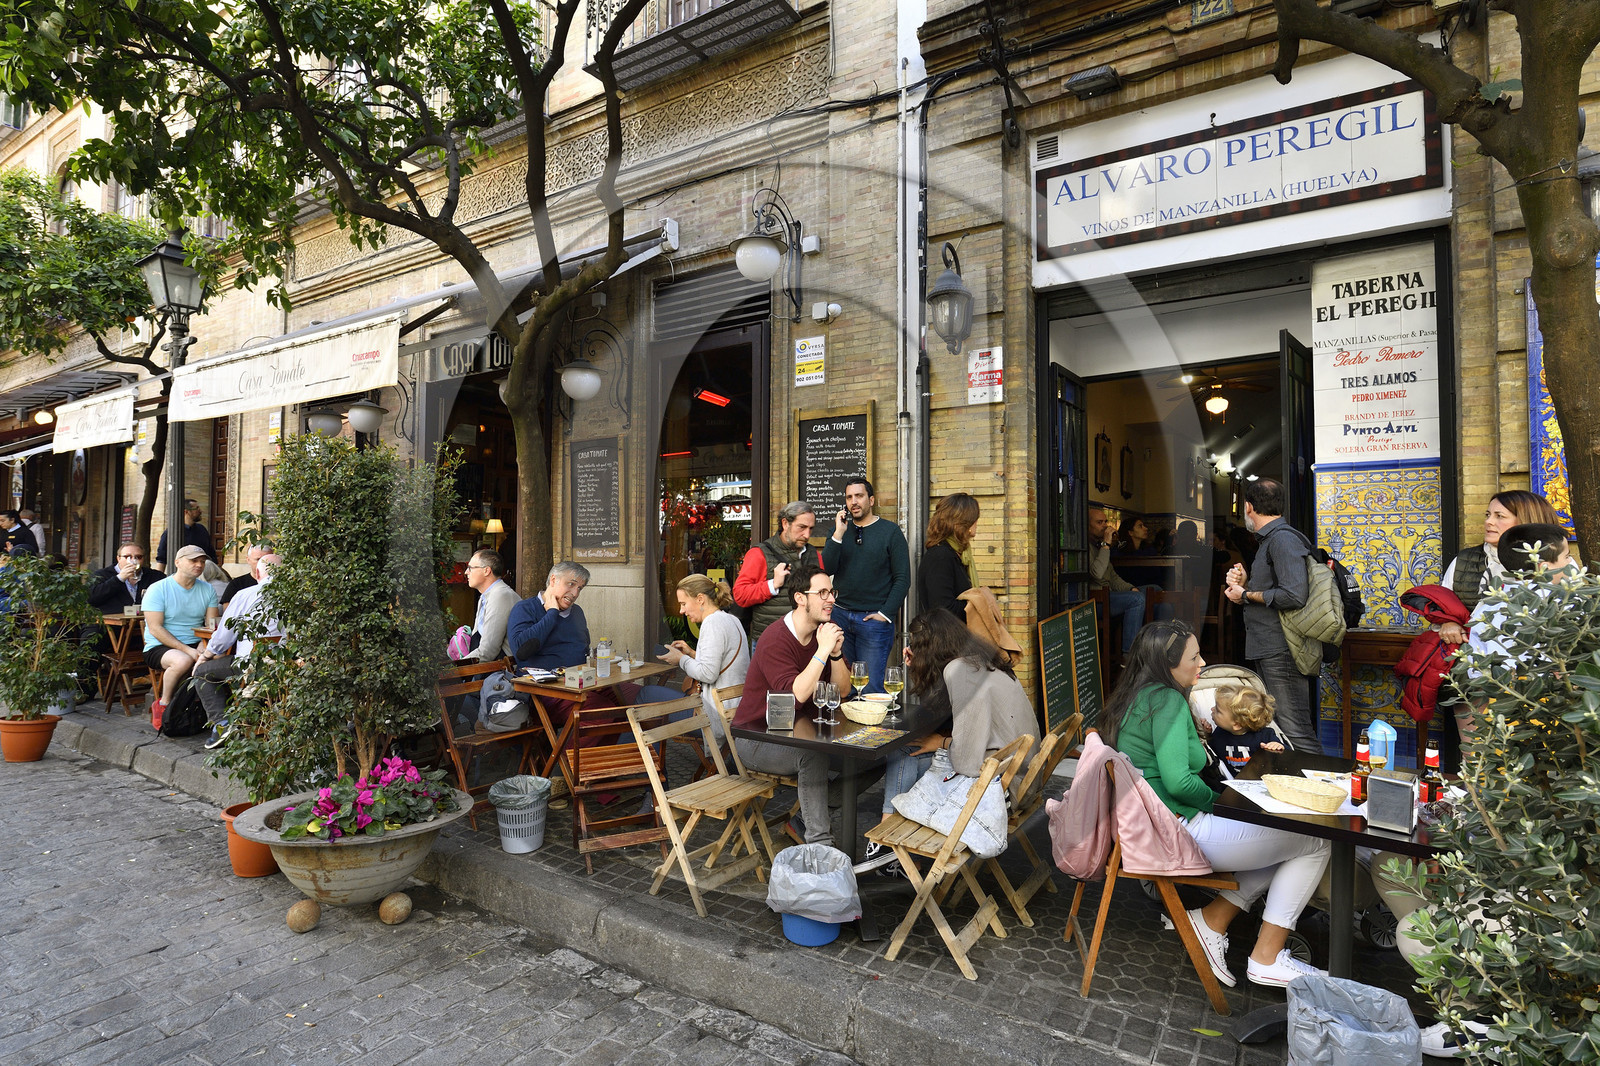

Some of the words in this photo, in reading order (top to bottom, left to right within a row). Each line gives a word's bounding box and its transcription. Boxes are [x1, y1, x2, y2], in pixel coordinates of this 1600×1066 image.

[1200, 0, 1224, 17] 22
[1053, 147, 1212, 206] ALVARO
[1223, 101, 1418, 168] PEREGIL
[1082, 217, 1129, 236] VINOS
[1134, 211, 1155, 227] DE
[1159, 187, 1277, 222] MANZANILLA
[1282, 167, 1378, 200] (HUELVA)
[1332, 271, 1425, 300] TABERNA
[1316, 304, 1341, 323] EL
[1314, 335, 1377, 350] MANZANILLAS
[440, 342, 475, 376] CASA
[1333, 350, 1370, 368] Pedro
[1375, 346, 1425, 363] Romero
[239, 370, 262, 393] Casa
[269, 359, 306, 387] Tomate
[970, 372, 1001, 381] Alarma
[1341, 376, 1369, 389] TRES
[1372, 370, 1417, 386] ALAMOS
[1352, 392, 1374, 402] PEDRO
[1375, 389, 1407, 401] XIMENEZ
[1344, 412, 1376, 421] BRANDY
[1378, 411, 1390, 419] DE
[1392, 409, 1415, 418] JEREZ
[812, 424, 830, 433] CASA
[831, 421, 856, 430] TOMATE
[1334, 445, 1365, 454] SOLERA
[1366, 443, 1389, 452] GRAN
[1391, 441, 1428, 451] RESERVA
